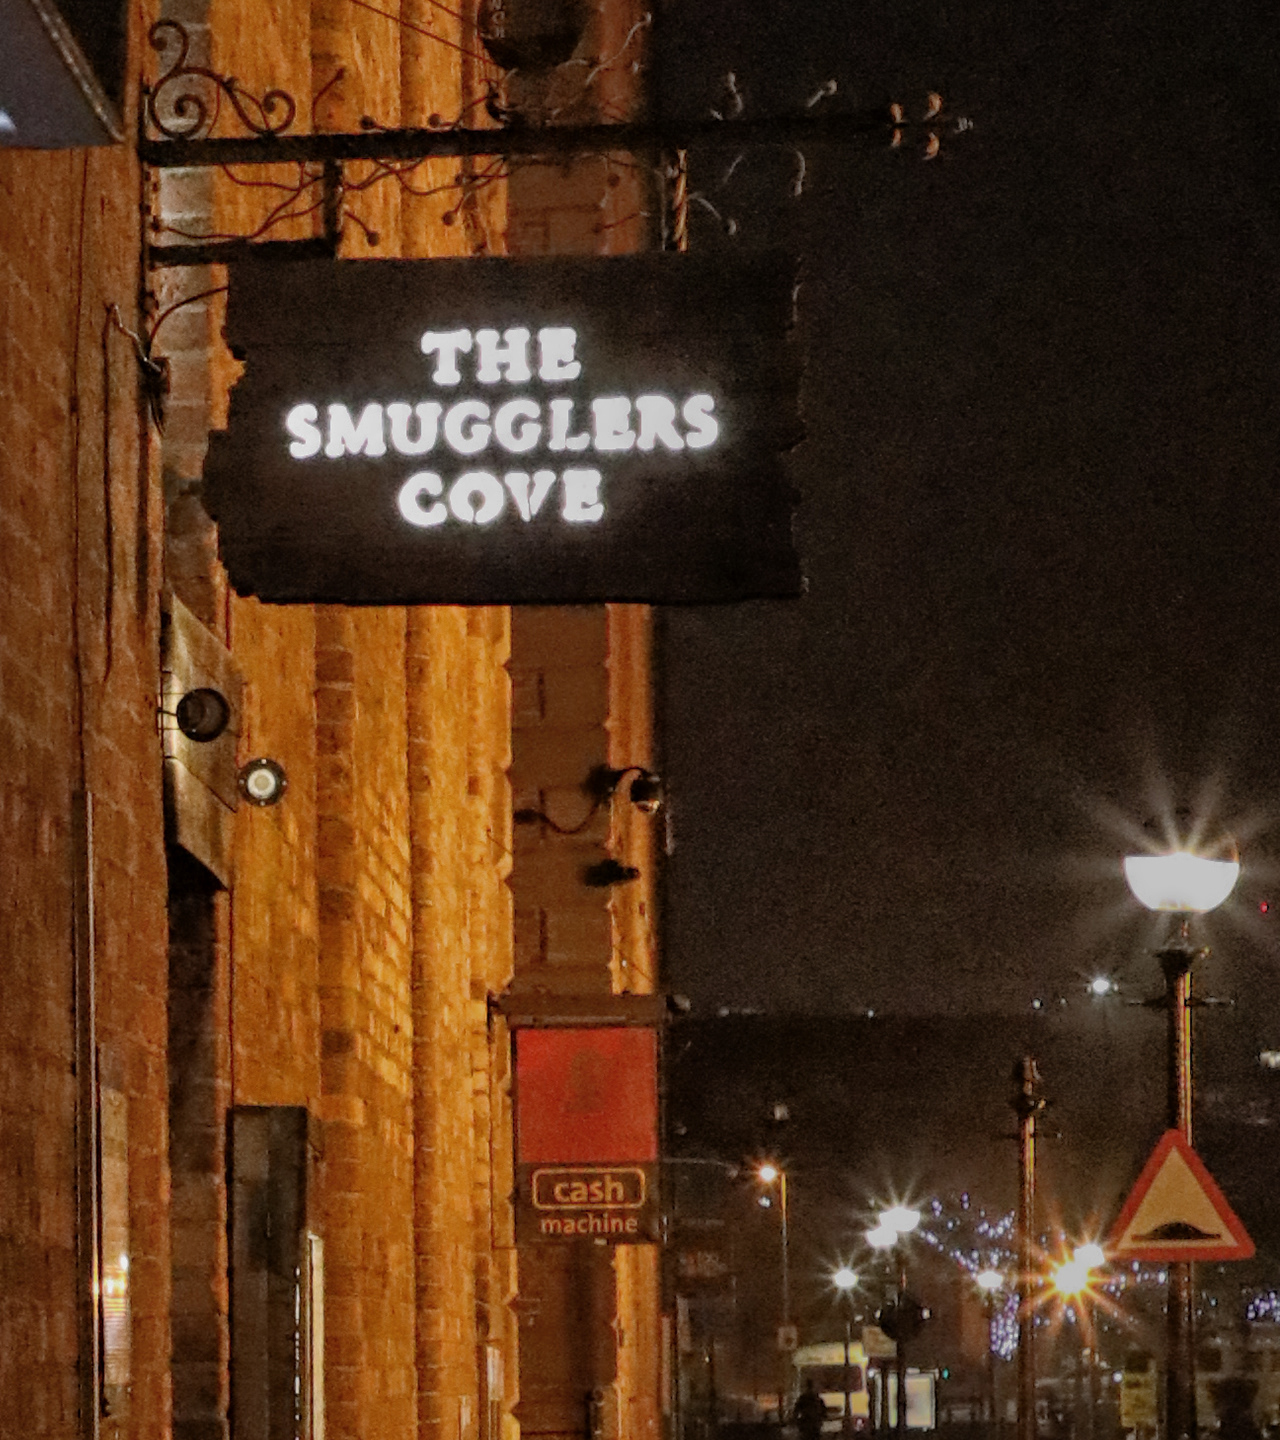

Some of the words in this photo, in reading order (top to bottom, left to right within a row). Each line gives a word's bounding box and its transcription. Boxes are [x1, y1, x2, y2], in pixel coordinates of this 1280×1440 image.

[420, 327, 581, 385] THE
[285, 395, 720, 458] SMUGGLERS
[397, 469, 605, 526] COVE
[553, 1173, 625, 1203] cash
[541, 1211, 639, 1235] machine
